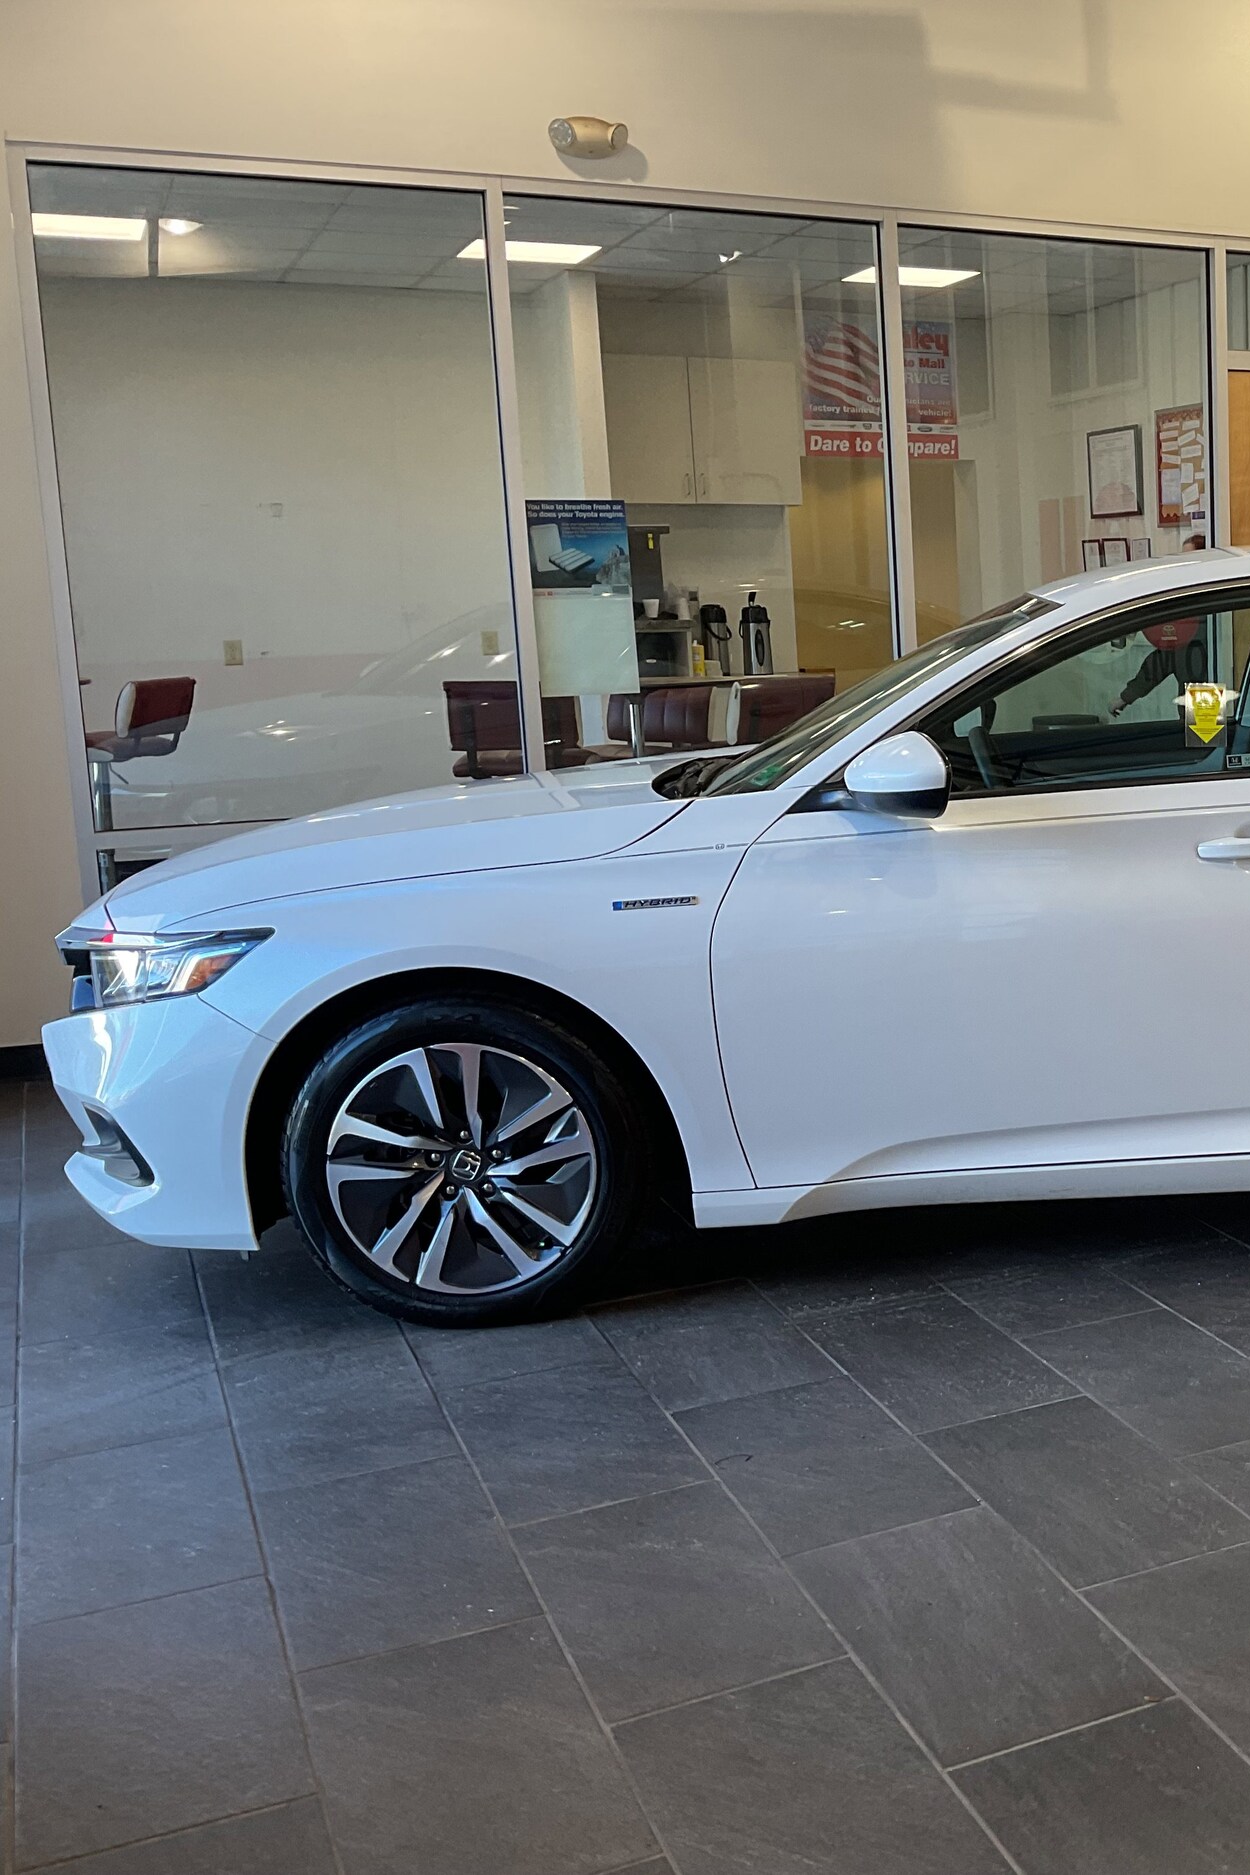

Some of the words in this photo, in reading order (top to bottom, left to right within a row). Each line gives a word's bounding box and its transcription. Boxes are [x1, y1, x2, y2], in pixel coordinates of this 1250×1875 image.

[919, 358, 945, 369] Mall
[809, 404, 840, 414] factory
[810, 435, 850, 451] Dare
[855, 437, 872, 452] to
[574, 510, 598, 519] Toyota
[624, 897, 691, 908] HYBRID
